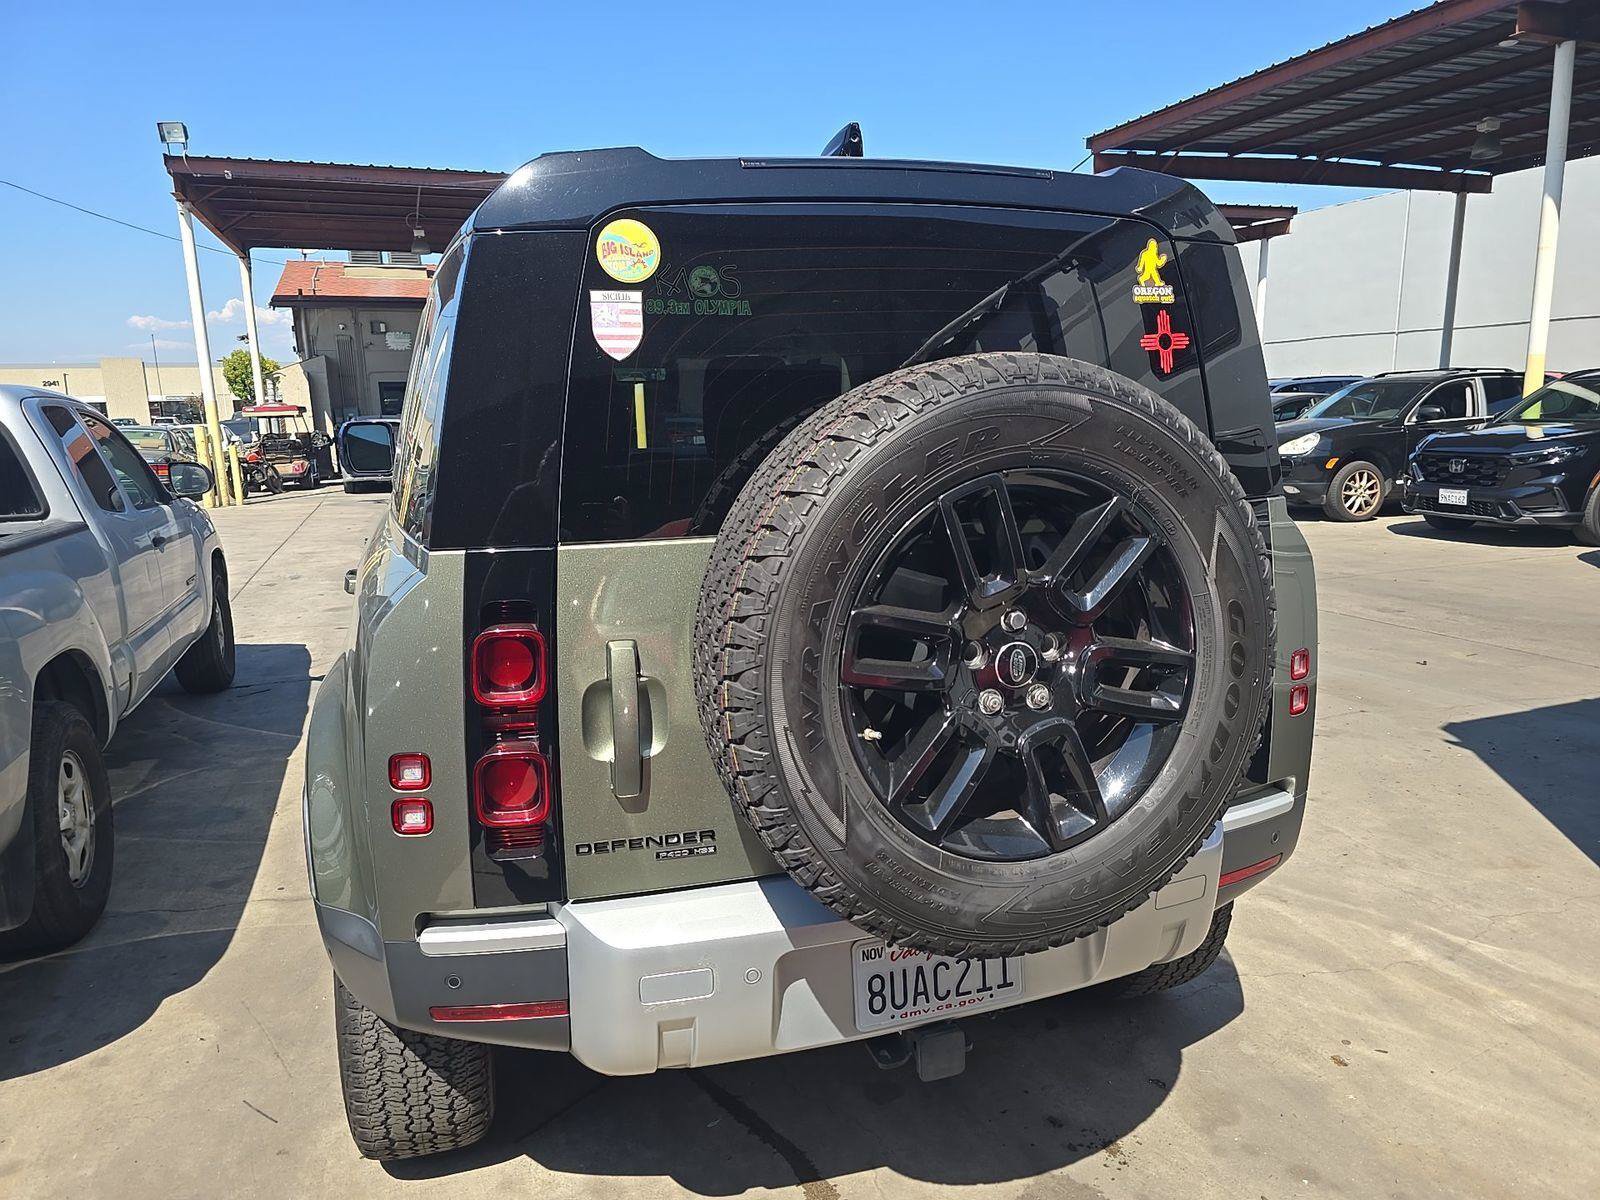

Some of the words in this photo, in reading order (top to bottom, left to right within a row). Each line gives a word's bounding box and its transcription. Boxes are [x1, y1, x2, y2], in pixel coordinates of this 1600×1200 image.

[602, 241, 617, 259] BIG
[619, 243, 654, 258] ISLAND
[1133, 286, 1173, 296] OREGON
[694, 299, 752, 316] OLYMPIA
[798, 424, 1002, 753] WRANGLER
[1070, 598, 1246, 901] GOODYEAR
[575, 829, 716, 857] DEFENDER
[861, 947, 884, 962] NOV
[867, 955, 1014, 1015] 8UAC211
[899, 995, 985, 1019] dmv.ca.gov
